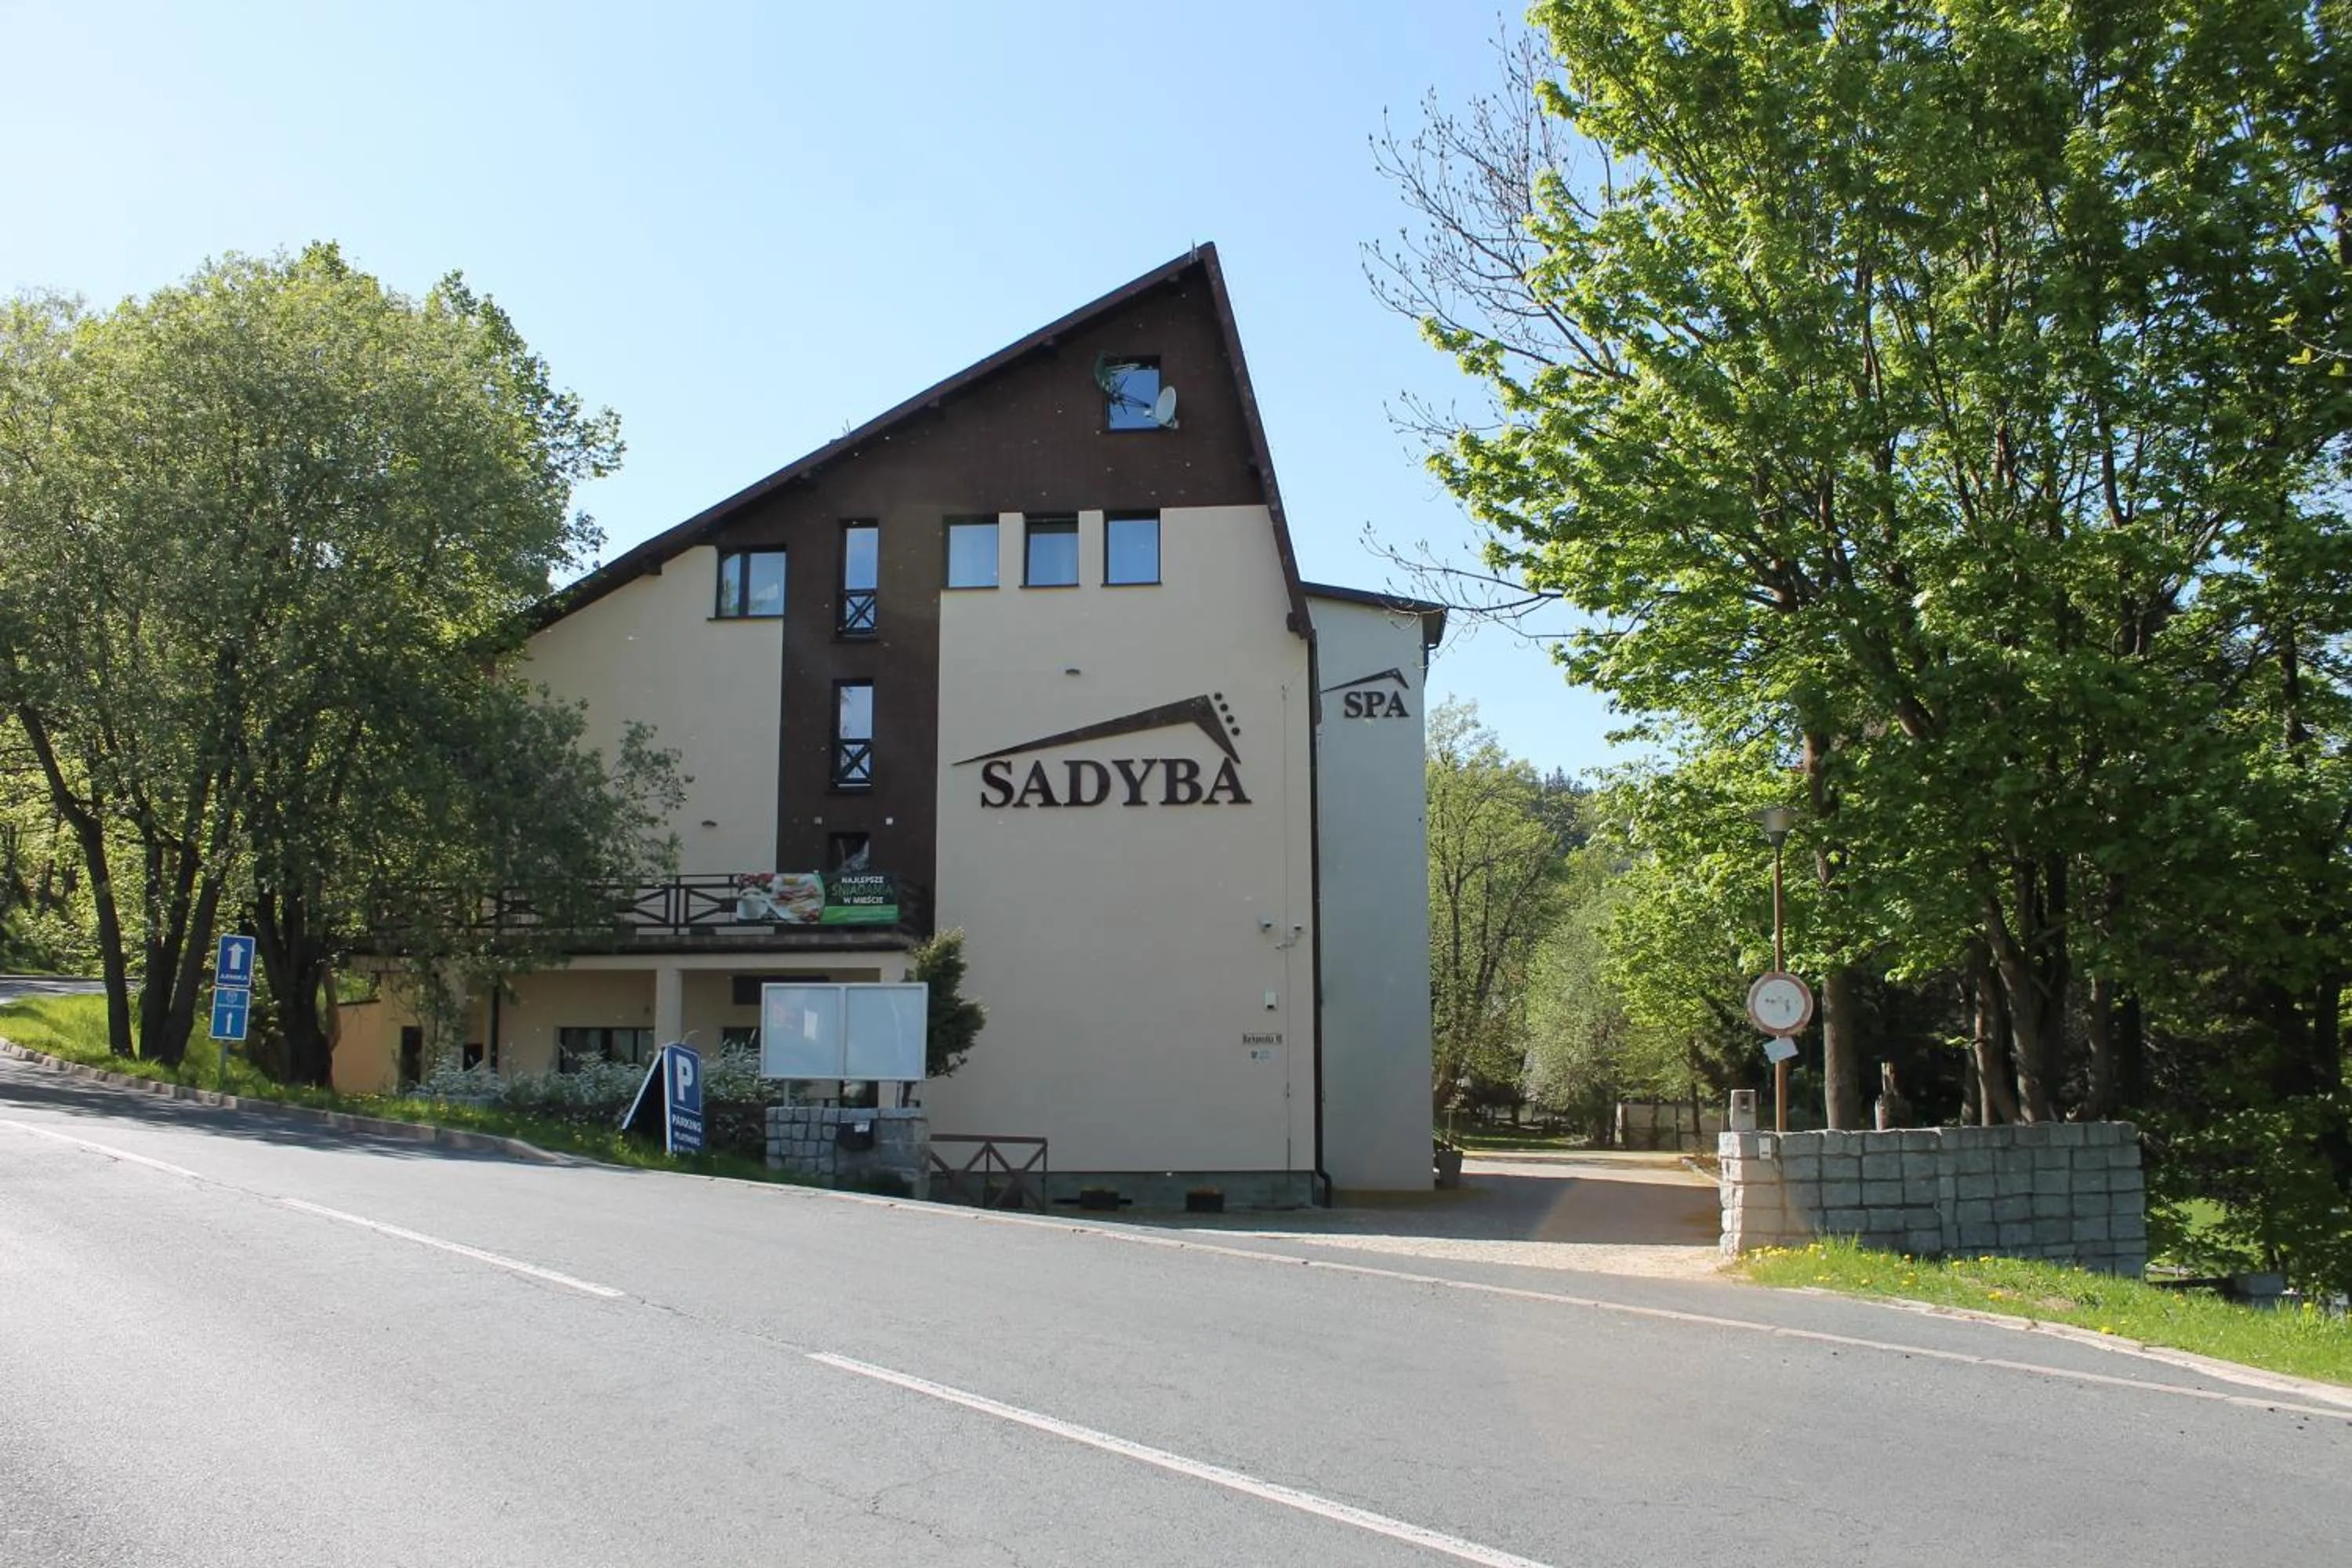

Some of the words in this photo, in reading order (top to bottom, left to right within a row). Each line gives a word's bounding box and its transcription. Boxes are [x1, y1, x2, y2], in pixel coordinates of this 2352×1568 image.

[1344, 690, 1410, 719] SPA
[980, 757, 1252, 809] SADYBA
[840, 876, 884, 884] NAJLEPSZE
[675, 1053, 694, 1102] P
[672, 1113, 702, 1134] PARKING
